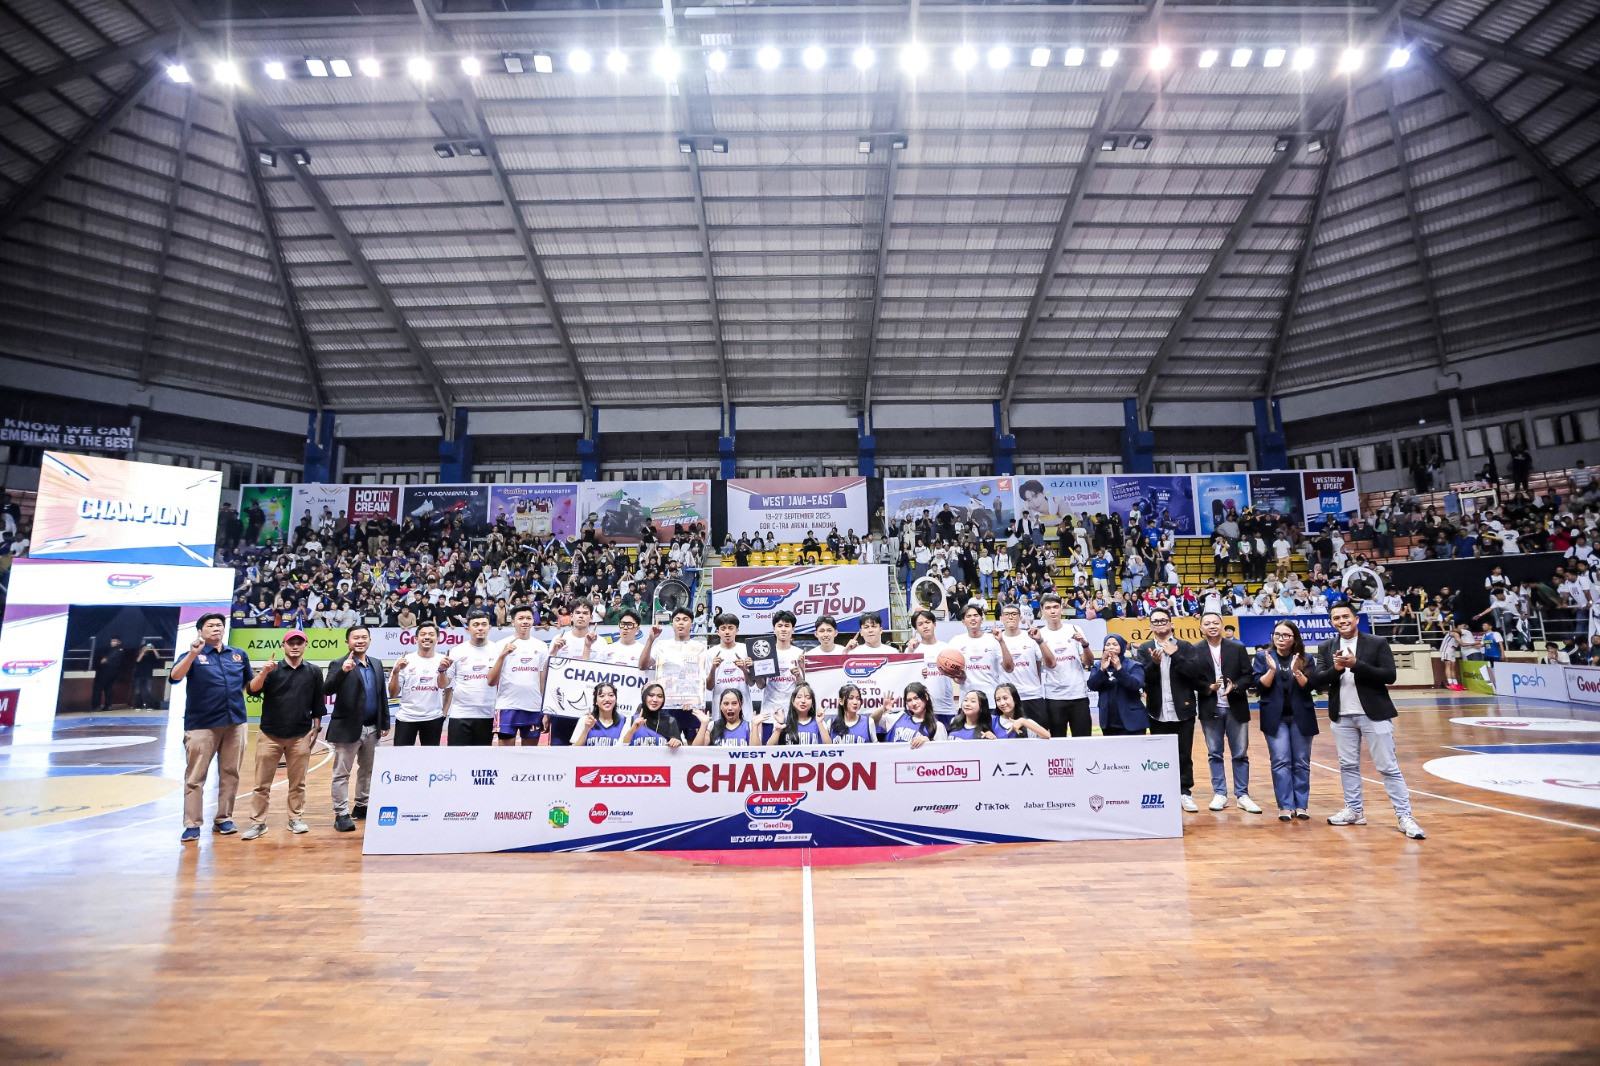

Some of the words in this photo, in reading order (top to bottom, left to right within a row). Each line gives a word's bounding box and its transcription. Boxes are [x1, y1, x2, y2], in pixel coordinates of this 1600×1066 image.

[4, 418, 60, 433] KNOW
[66, 425, 92, 435] WE
[97, 427, 131, 436] CAN
[63, 434, 75, 445] IS
[78, 435, 102, 447] THE
[104, 437, 134, 449] BEST
[1312, 476, 1346, 484] LIVESTREAM
[1322, 482, 1343, 490] UPDATE
[762, 496, 786, 507] WEST
[788, 494, 833, 506] JAVA-EAST
[1322, 496, 1340, 505] DBL
[354, 502, 390, 512] CREAM
[79, 498, 189, 526] CHAMPION
[784, 512, 815, 520] SEPTEMBER
[815, 512, 831, 520] 2025
[660, 515, 699, 528] BENER
[759, 522, 771, 530] GOR
[811, 521, 837, 529] BANDUNG
[808, 582, 841, 597] LET'S
[753, 596, 770, 605] DBL
[793, 599, 823, 616] GET
[823, 596, 866, 616] LOUD
[1306, 619, 1332, 629] MILK
[1314, 631, 1339, 640] BLAST
[563, 667, 649, 689] CHAMPION
[716, 676, 745, 685] CHAMPION
[1512, 667, 1546, 694] posh
[869, 687, 881, 696] TO
[728, 751, 766, 759] WEST
[771, 750, 845, 758] JAVA-EAST
[471, 769, 498, 778] ULTRA
[1048, 767, 1074, 776] CREAM
[394, 774, 418, 782] Biznet
[428, 769, 457, 788] posh
[473, 777, 496, 786] MILK
[599, 774, 666, 784] HONDA
[686, 761, 877, 793] CHAMPION
[1140, 794, 1165, 805] DBL
[913, 804, 959, 812] proteam
[1046, 801, 1076, 809] Ekspres
[761, 806, 777, 814] DBL
[380, 811, 395, 819] DBL
[494, 811, 532, 820] MAINBASKET
[745, 835, 758, 843] GET
[757, 834, 774, 842] LOUD
